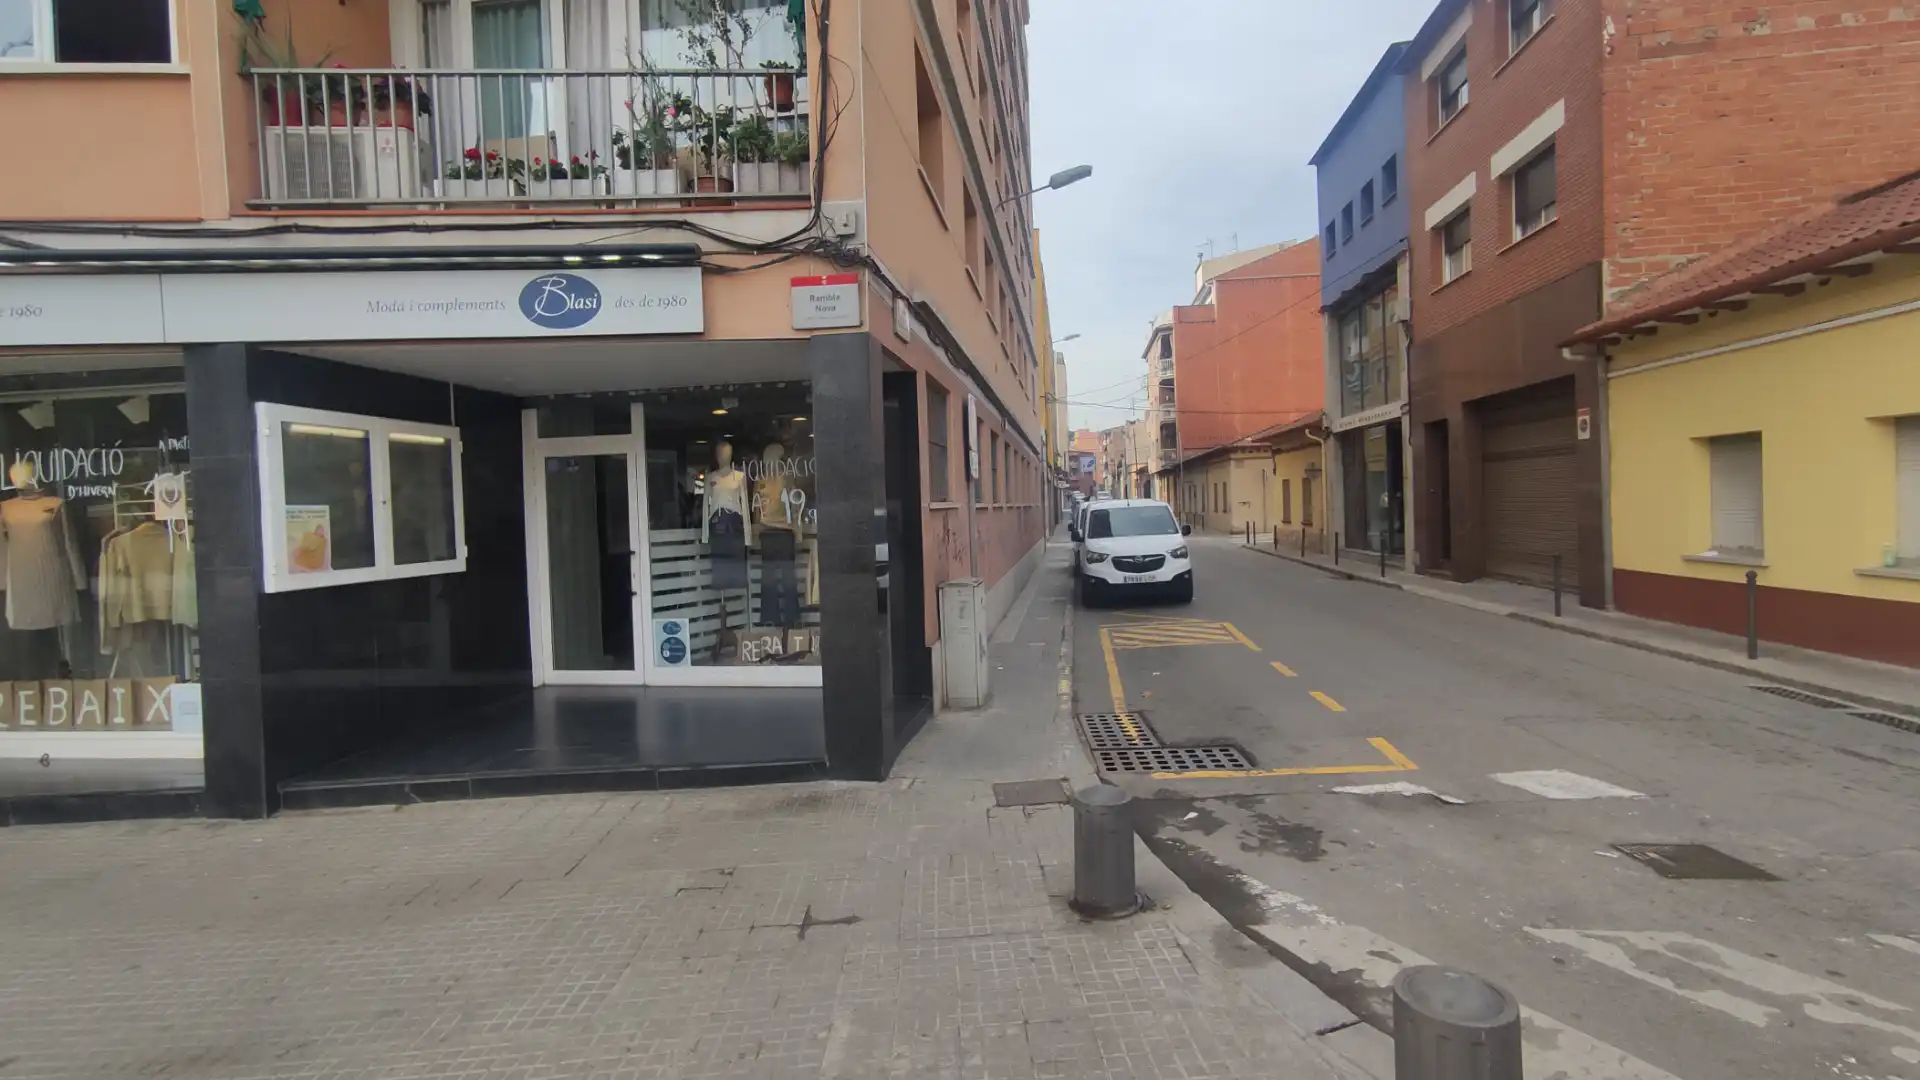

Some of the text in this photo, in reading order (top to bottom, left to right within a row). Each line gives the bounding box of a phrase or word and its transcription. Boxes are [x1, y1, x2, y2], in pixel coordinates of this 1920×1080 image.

[529, 276, 597, 321] Blasi
[614, 294, 688, 310] des de 1980
[809, 293, 841, 302] Rambla
[10, 303, 43, 321] 1980
[366, 300, 405, 313] Moda
[417, 298, 507, 315] complements
[815, 304, 836, 313] Nova
